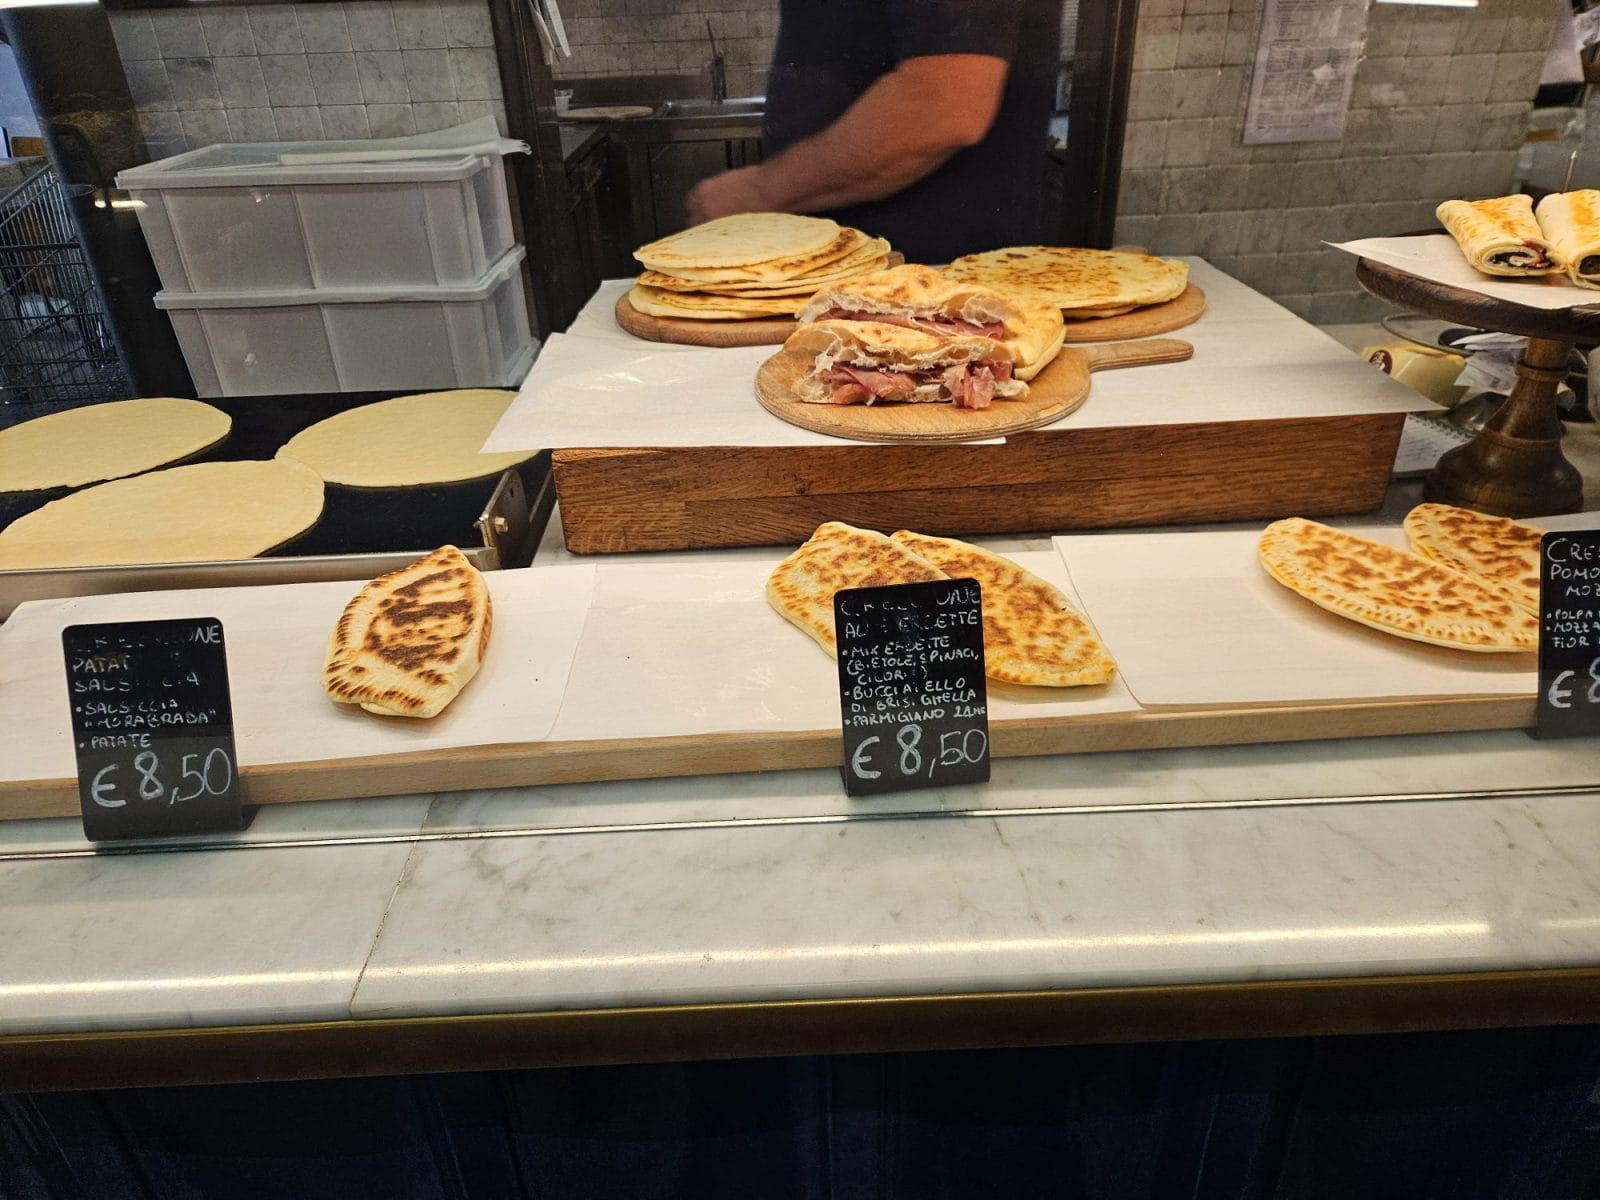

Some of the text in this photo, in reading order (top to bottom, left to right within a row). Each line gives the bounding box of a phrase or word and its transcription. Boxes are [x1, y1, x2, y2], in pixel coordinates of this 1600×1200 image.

[1555, 609, 1593, 621] POLPA
[1548, 670, 1576, 708] €
[851, 703, 867, 713] DI
[853, 707, 945, 726] PARMIGIANO
[91, 733, 152, 749] PATATE
[852, 724, 987, 779] € 8,50
[91, 747, 232, 808] € 8,50
